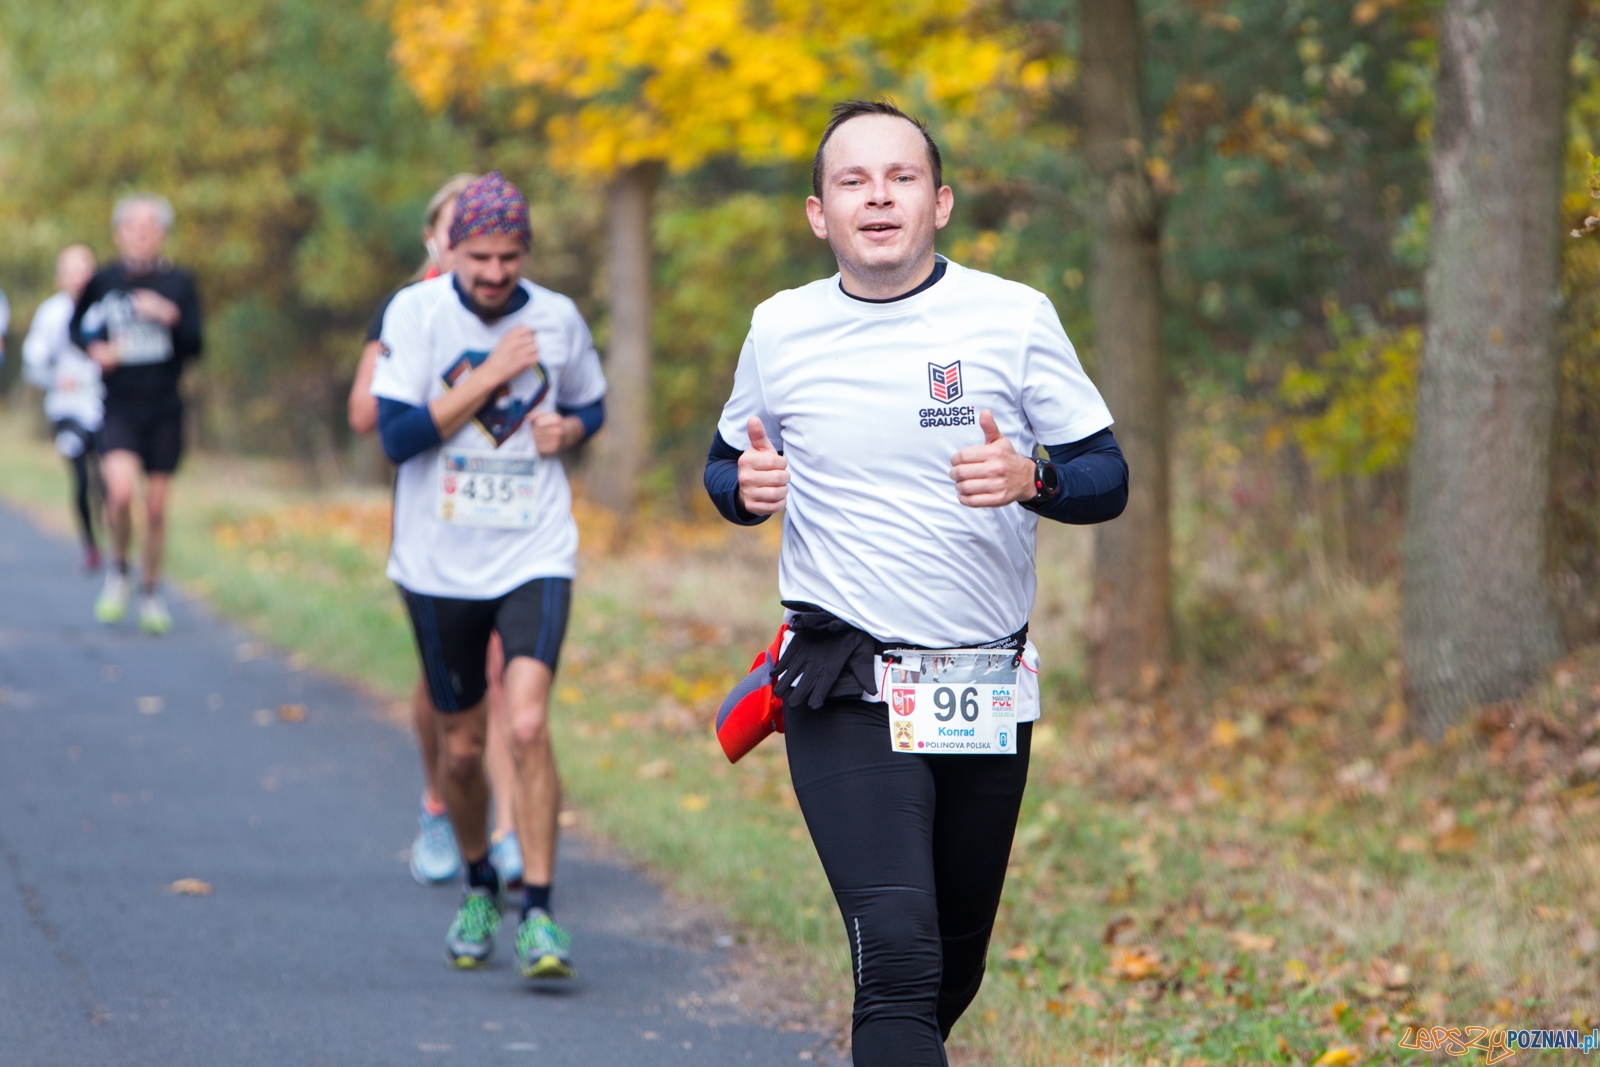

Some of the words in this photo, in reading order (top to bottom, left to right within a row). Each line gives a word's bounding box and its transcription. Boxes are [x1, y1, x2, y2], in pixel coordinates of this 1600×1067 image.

[919, 407, 974, 418] GRAUSCH
[920, 416, 975, 428] GRAUSCH
[462, 474, 514, 502] 435
[933, 686, 979, 722] 96
[938, 726, 975, 737] Konrad
[925, 741, 965, 749] POLINOVA
[966, 741, 991, 749] POLSKA
